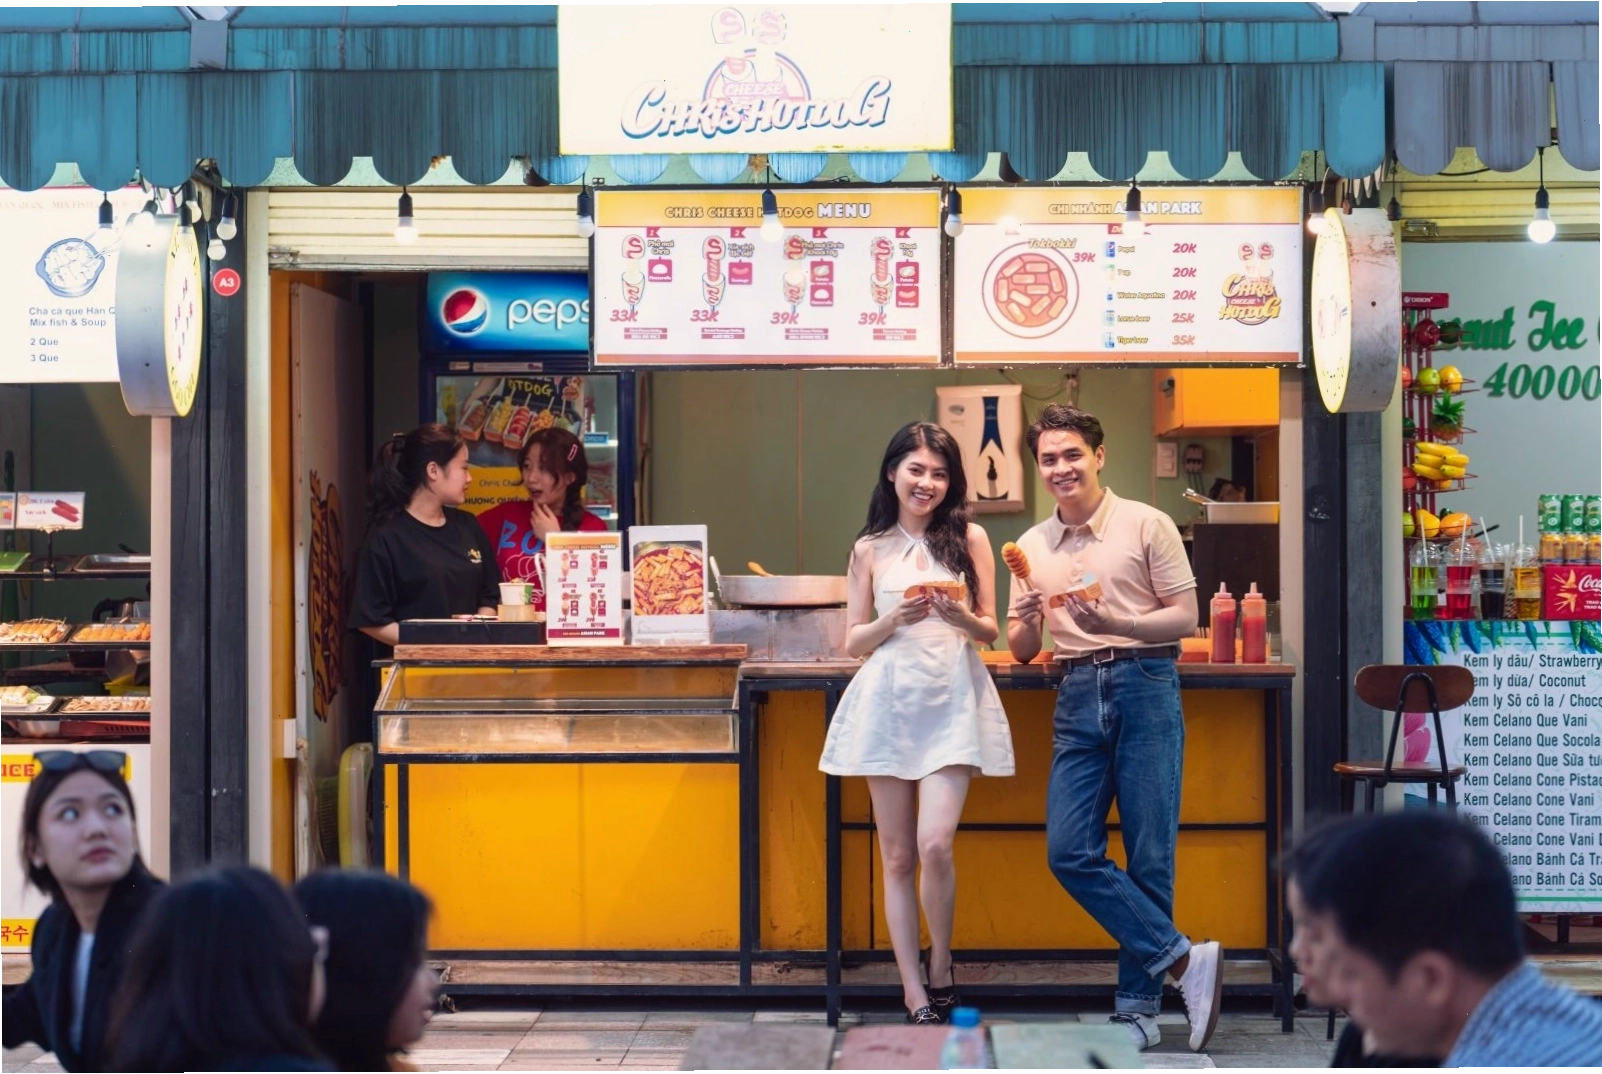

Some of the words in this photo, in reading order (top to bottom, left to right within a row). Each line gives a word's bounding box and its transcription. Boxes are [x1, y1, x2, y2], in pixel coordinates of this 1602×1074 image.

[665, 207, 703, 218] CHRIS
[707, 207, 754, 218] CHEESE
[757, 207, 814, 218] HTDOG
[817, 203, 872, 218] MENU
[1048, 204, 1069, 215] CHI
[1161, 202, 1202, 215] PARK
[1172, 243, 1197, 253] 20K
[1072, 252, 1096, 263] 39K
[1172, 267, 1197, 278] 20K
[219, 276, 235, 287] A3
[1172, 290, 1197, 301] 20K
[66, 309, 83, 319] que
[610, 310, 638, 322] 33K
[690, 310, 719, 322] 33K
[770, 312, 799, 324] 39K
[858, 312, 887, 325] 39K
[1171, 313, 1195, 323] 25K
[30, 318, 46, 327] Mix
[50, 318, 68, 327] fish
[72, 318, 78, 327] &
[82, 318, 107, 328] Soup
[30, 338, 36, 346] 2
[39, 338, 59, 347] Que
[1172, 335, 1196, 345] 35K
[31, 354, 36, 362] 3
[39, 354, 59, 363] Que
[1464, 654, 1489, 667] Kem
[1494, 654, 1503, 670] ly
[1539, 654, 1602, 670] Strawberry
[1473, 676, 1489, 687] em
[1494, 674, 1503, 690] ly
[1540, 674, 1587, 687] Coconut
[1494, 694, 1503, 709] ly
[1544, 694, 1554, 707] la
[1464, 713, 1489, 727] Kem
[1493, 713, 1532, 727] Celano
[1537, 714, 1558, 727] Que
[1563, 713, 1588, 727] Vani
[1464, 733, 1489, 747] Kem
[1493, 733, 1532, 747] Celano
[1537, 733, 1558, 747] Que
[1563, 733, 1601, 747] Socola
[1464, 753, 1489, 767] Kem
[1493, 753, 1532, 767] Celano
[1537, 753, 1558, 767] Que
[1464, 773, 1489, 786] Kem
[1493, 773, 1532, 786] Celano
[1537, 773, 1565, 786] Cone
[1464, 793, 1489, 806] Kem
[1493, 793, 1532, 806] Celano
[1537, 793, 1565, 806] Cone
[1569, 793, 1594, 806] Vani
[1493, 813, 1532, 826] Celano
[1537, 813, 1565, 826] Cone
[1493, 832, 1532, 846] Celano
[1537, 833, 1565, 846] Cone
[1569, 833, 1594, 846] Vani
[1502, 853, 1532, 866] elano
[1511, 875, 1532, 886] ano
